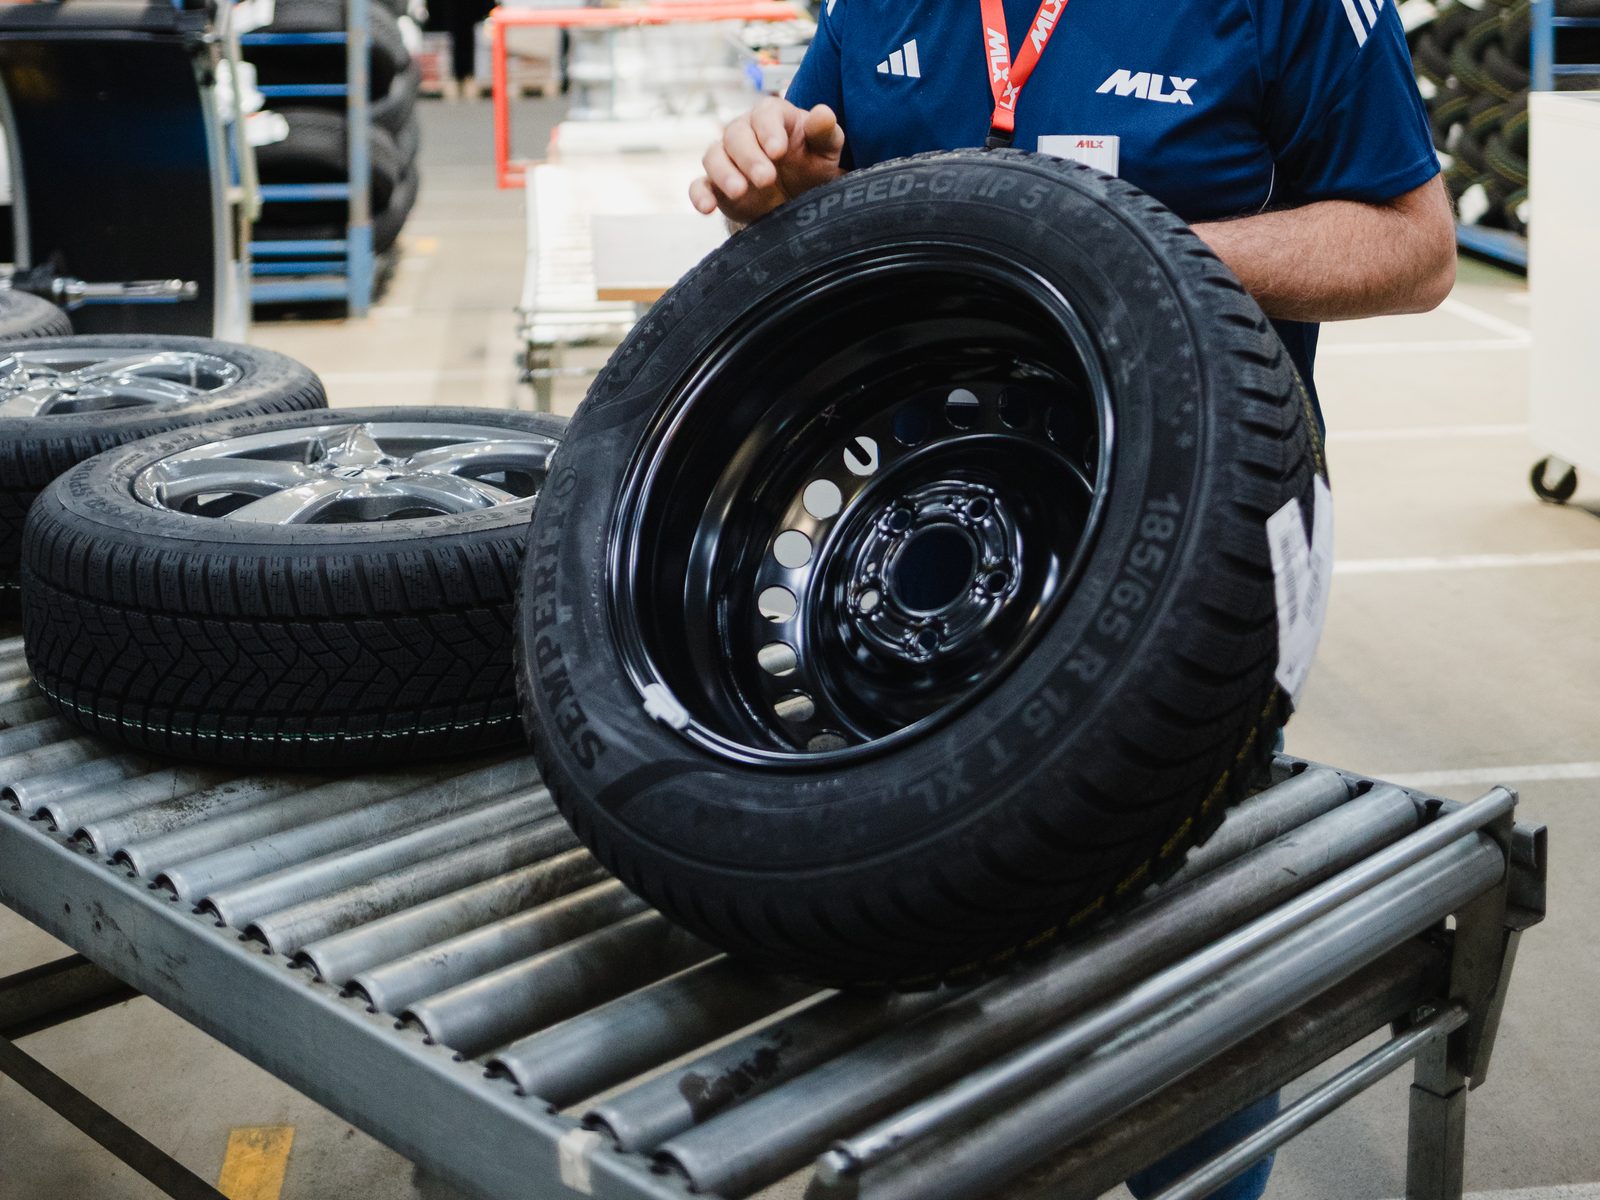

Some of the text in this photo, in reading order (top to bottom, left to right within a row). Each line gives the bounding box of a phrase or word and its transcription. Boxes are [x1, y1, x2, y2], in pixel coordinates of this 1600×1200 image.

[987, 27, 1009, 83] MLX
[1000, 81, 1020, 110] LX
[1095, 68, 1198, 105] MLX
[1075, 140, 1104, 149] MLX
[1019, 184, 1050, 209] 5
[1096, 492, 1180, 642] 185/65
[533, 510, 602, 771] SEMPERIT
[1064, 647, 1107, 682] R
[1021, 687, 1069, 737] 15
[908, 756, 974, 811] XL
